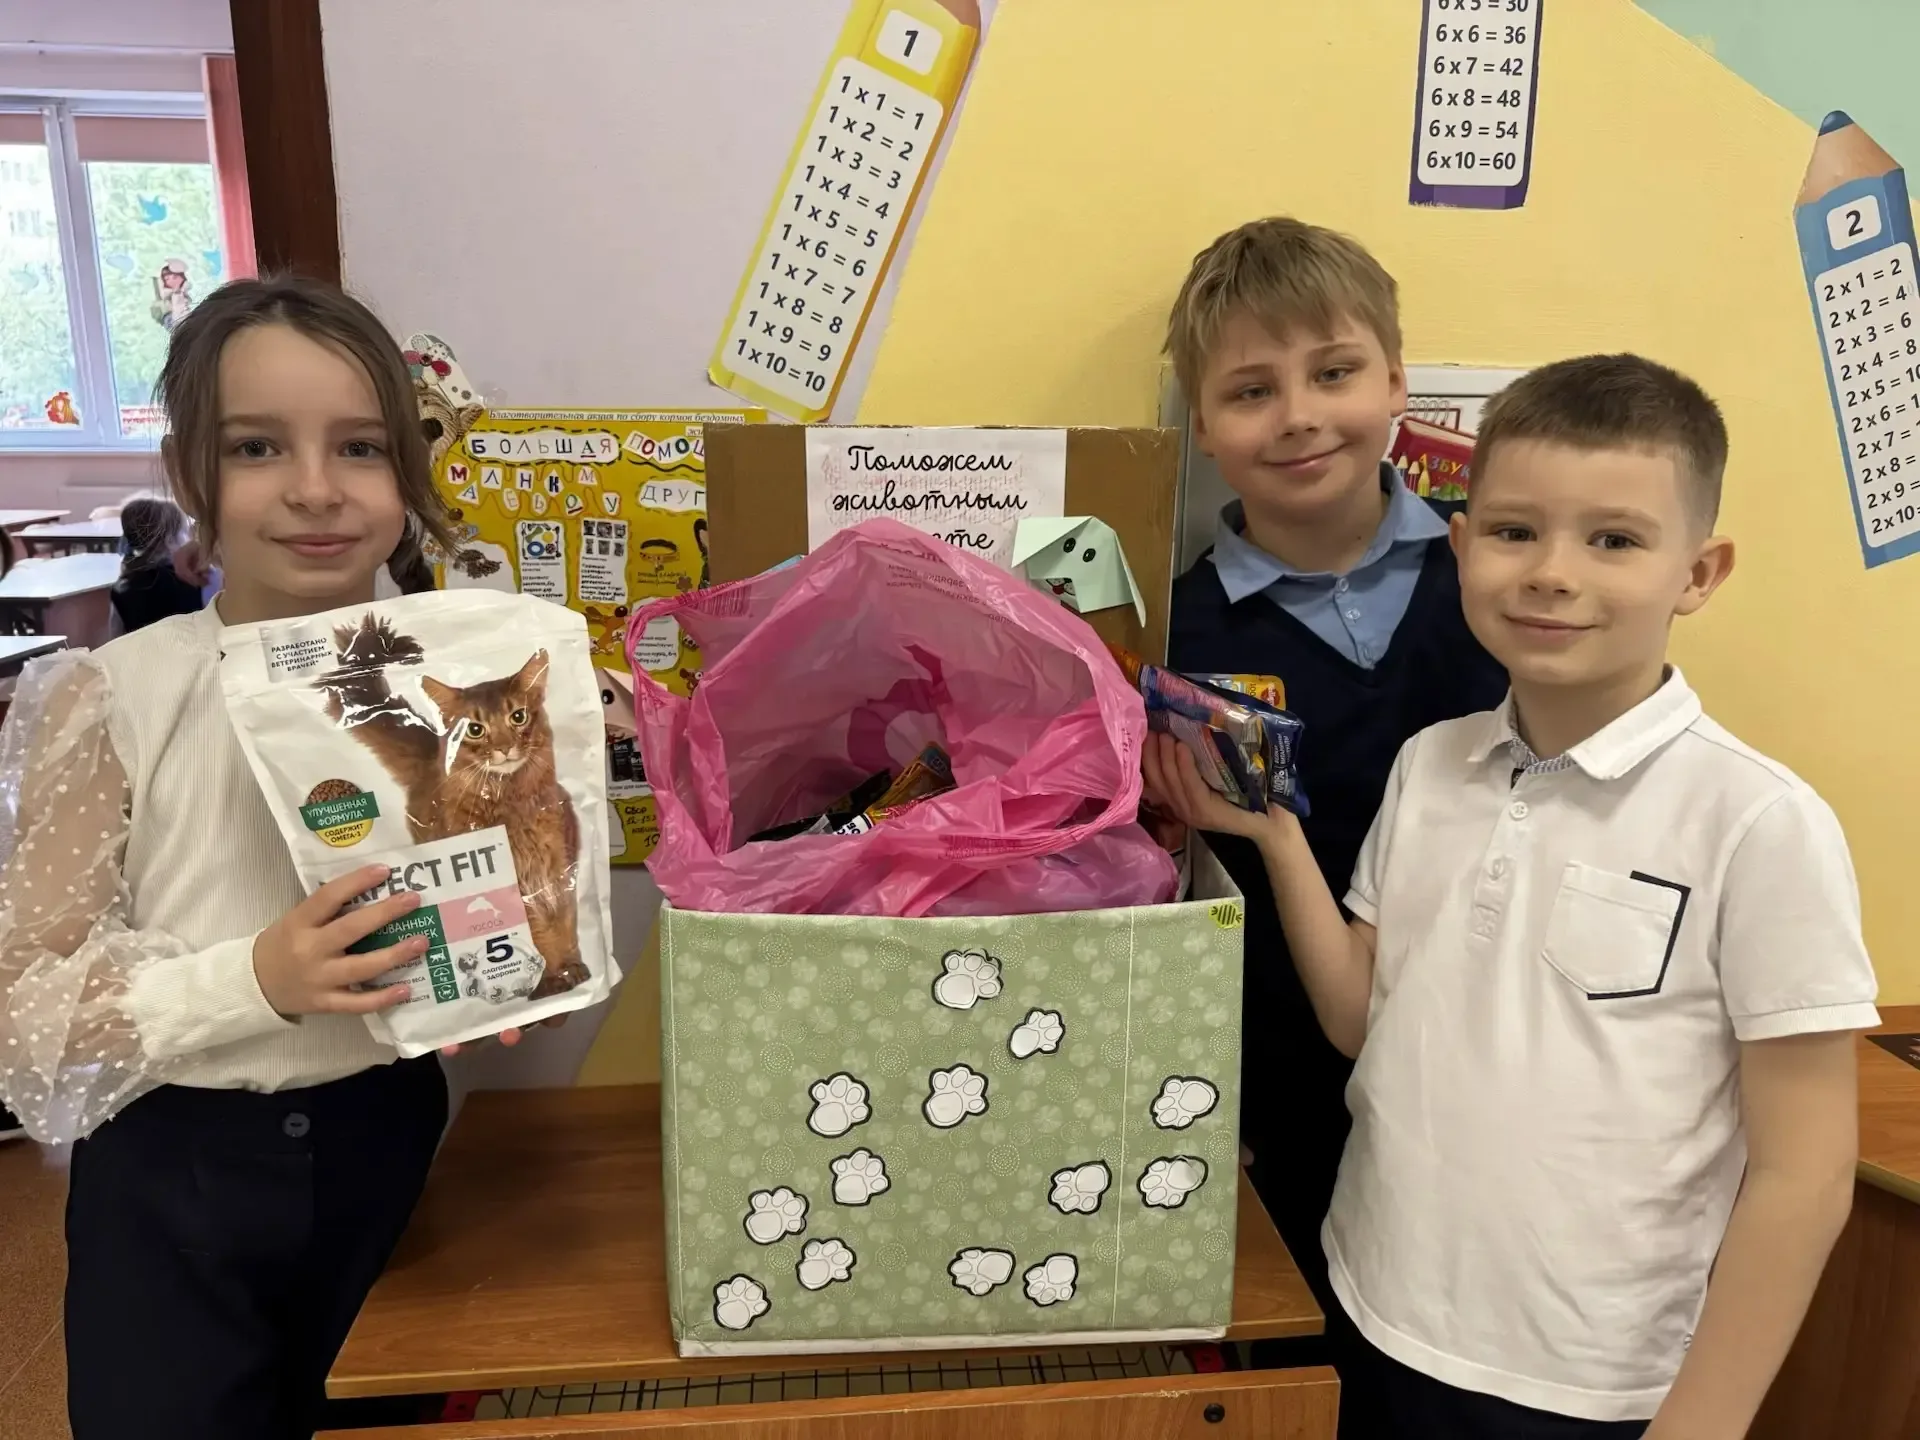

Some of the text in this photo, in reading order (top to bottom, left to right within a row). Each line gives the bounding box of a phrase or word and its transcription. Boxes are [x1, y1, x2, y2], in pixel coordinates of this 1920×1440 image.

[903, 30, 919, 58] 1
[1435, 23, 1448, 42] 6
[1468, 24, 1480, 43] 6
[1503, 25, 1526, 45] 36
[1433, 55, 1445, 75] 6
[1466, 56, 1478, 75] 7
[1499, 57, 1523, 77] 42
[841, 75, 851, 94] 1
[876, 93, 886, 111] 1
[914, 112, 925, 130] 1
[1431, 87, 1443, 106] 6
[1462, 88, 1475, 107] 8
[1496, 89, 1521, 108] 48
[829, 105, 839, 124] 1
[860, 122, 876, 142] 2
[898, 141, 914, 161] 2
[1429, 119, 1441, 137] 6
[1461, 120, 1473, 138] 9
[1495, 121, 1519, 139] 54
[817, 135, 828, 153] 1
[848, 151, 863, 170] 3
[886, 170, 901, 189] 3
[805, 165, 816, 183] 1
[837, 183, 852, 201] 4
[875, 202, 889, 220] 4
[794, 194, 804, 212] 1
[825, 210, 841, 229] 5
[863, 228, 879, 248] 5
[1845, 209, 1864, 237] 2
[782, 223, 793, 241] 1
[814, 240, 829, 259] 6
[852, 259, 867, 277] 6
[771, 253, 781, 270] 1
[803, 267, 818, 286] 7
[841, 286, 856, 305] 7
[1824, 284, 1836, 302] 2
[1855, 271, 1865, 289] 1
[1890, 258, 1902, 276] 2
[759, 281, 770, 299] 1
[791, 297, 806, 316] 8
[828, 316, 843, 334] 8
[1829, 311, 1841, 329] 2
[1860, 298, 1873, 317] 2
[1895, 285, 1908, 301] 4
[748, 310, 758, 328] 1
[779, 326, 794, 344] 9
[817, 344, 832, 362] 9
[1834, 337, 1847, 355] 2
[1866, 325, 1877, 343] 3
[1900, 311, 1912, 329] 6
[1840, 364, 1852, 382] 2
[1872, 351, 1884, 368] 4
[1905, 338, 1917, 356] 8
[1846, 390, 1858, 408] 2
[1874, 379, 1886, 397] 5
[1851, 416, 1863, 434] 2
[1879, 405, 1891, 422] 6
[471, 438, 613, 455] БОЛЬШАЯ
[847, 445, 1013, 472] Поможем
[1418, 452, 1470, 478] АЗБУК
[1861, 467, 1873, 485] 2
[1889, 457, 1901, 473] 8
[640, 484, 705, 506] ДРУГ
[832, 480, 1028, 512] животным
[1866, 493, 1878, 509] 2
[1894, 482, 1905, 499] 9
[271, 637, 327, 653] РАЗРАБОТАНО
[283, 645, 325, 659] УЧАСТИЕМ
[271, 650, 333, 669] ВЕТЕРИНАРНЫХ
[306, 797, 368, 818] УЛУЧШЕННАЯ
[324, 823, 364, 838] СОДЕРЖИТ
[330, 831, 362, 843] ОМЕГА-3
[450, 844, 497, 883] FIT
[485, 934, 514, 964] 5
[411, 976, 426, 984] ВЕСА
